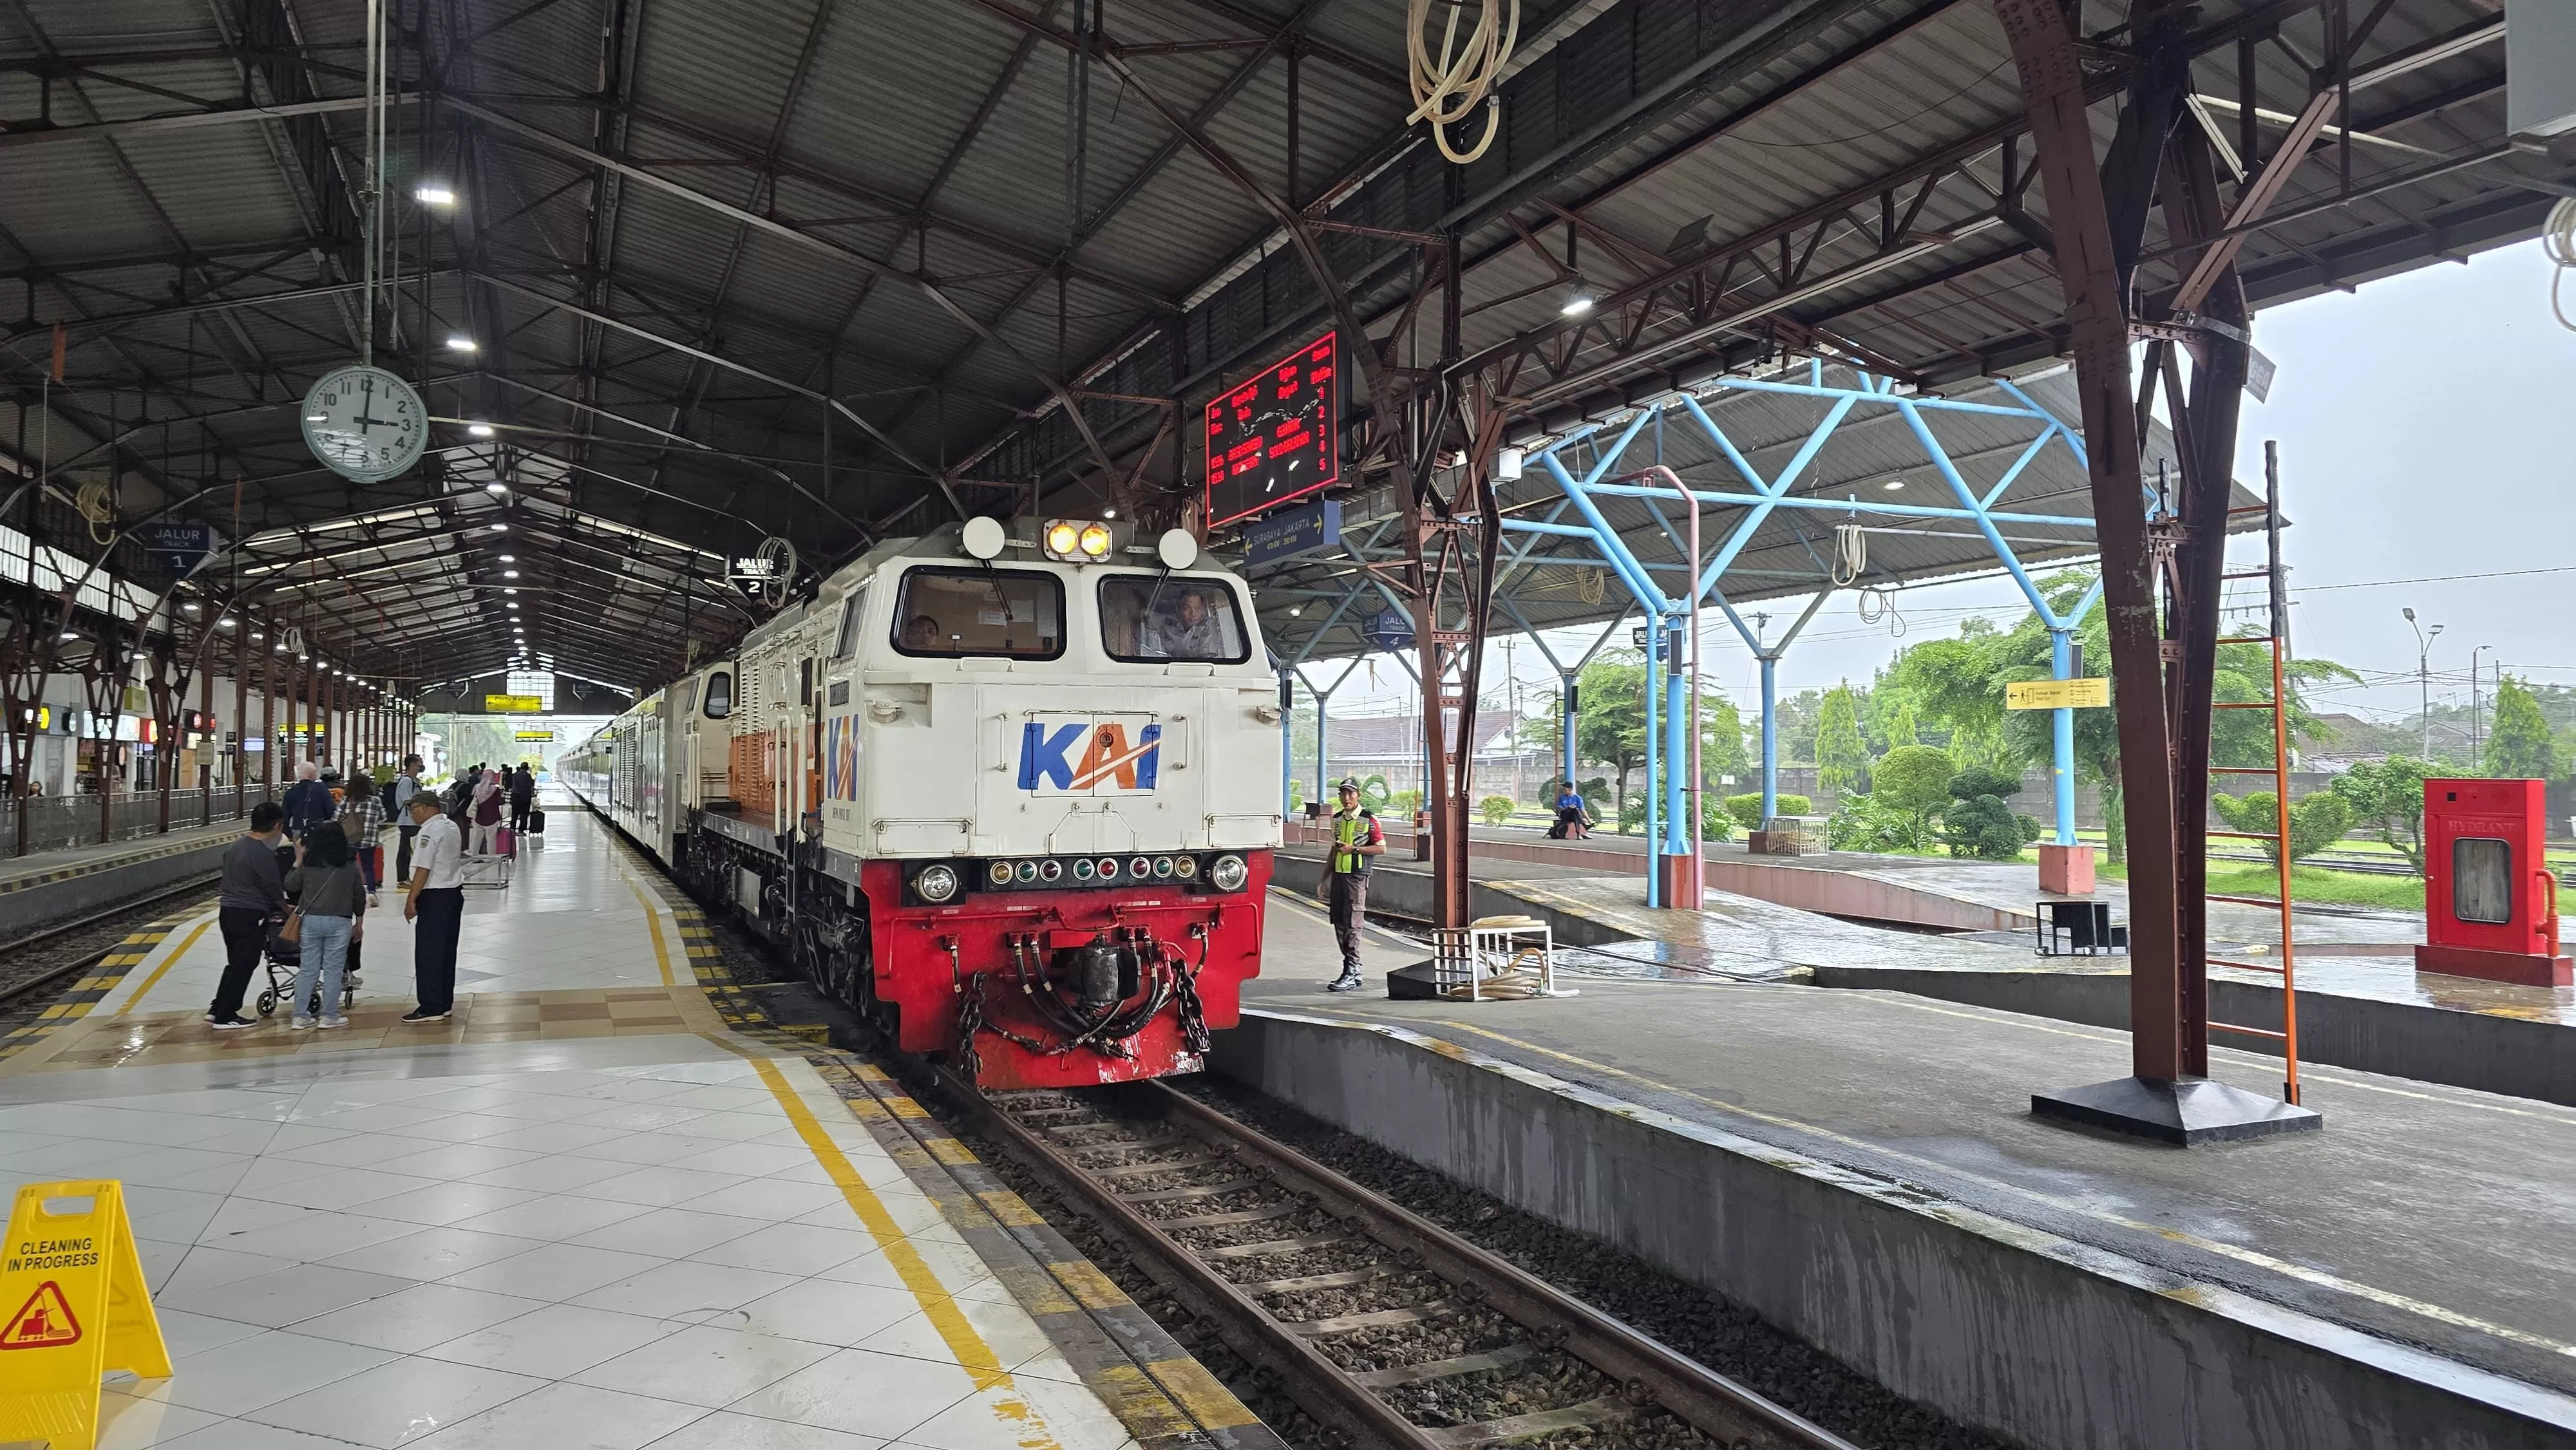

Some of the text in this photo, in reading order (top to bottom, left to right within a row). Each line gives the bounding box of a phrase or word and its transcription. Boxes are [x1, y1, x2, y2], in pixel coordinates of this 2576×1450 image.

[341, 381, 351, 395] 11
[361, 378, 374, 392] 12
[386, 386, 389, 399] 1
[325, 393, 337, 406] 10
[397, 400, 406, 413] 2
[1318, 405, 1325, 419] 2
[402, 419, 411, 431] 3
[1319, 424, 1325, 437] 3
[395, 436, 405, 449] 4
[381, 448, 390, 460] 5
[1319, 458, 1326, 471] 5
[155, 529, 200, 540] JALUR
[1253, 518, 1310, 545] SURABAYA JAKARTA
[172, 556, 185, 567] 1
[748, 581, 760, 592] 2
[1390, 636, 1399, 646] 4
[827, 714, 858, 802] KAI
[1018, 723, 1162, 790] KAI
[2448, 821, 2514, 833] HYDRANT
[21, 1238, 92, 1255] CLEANING
[7, 1252, 99, 1272] IN PROGRESS
